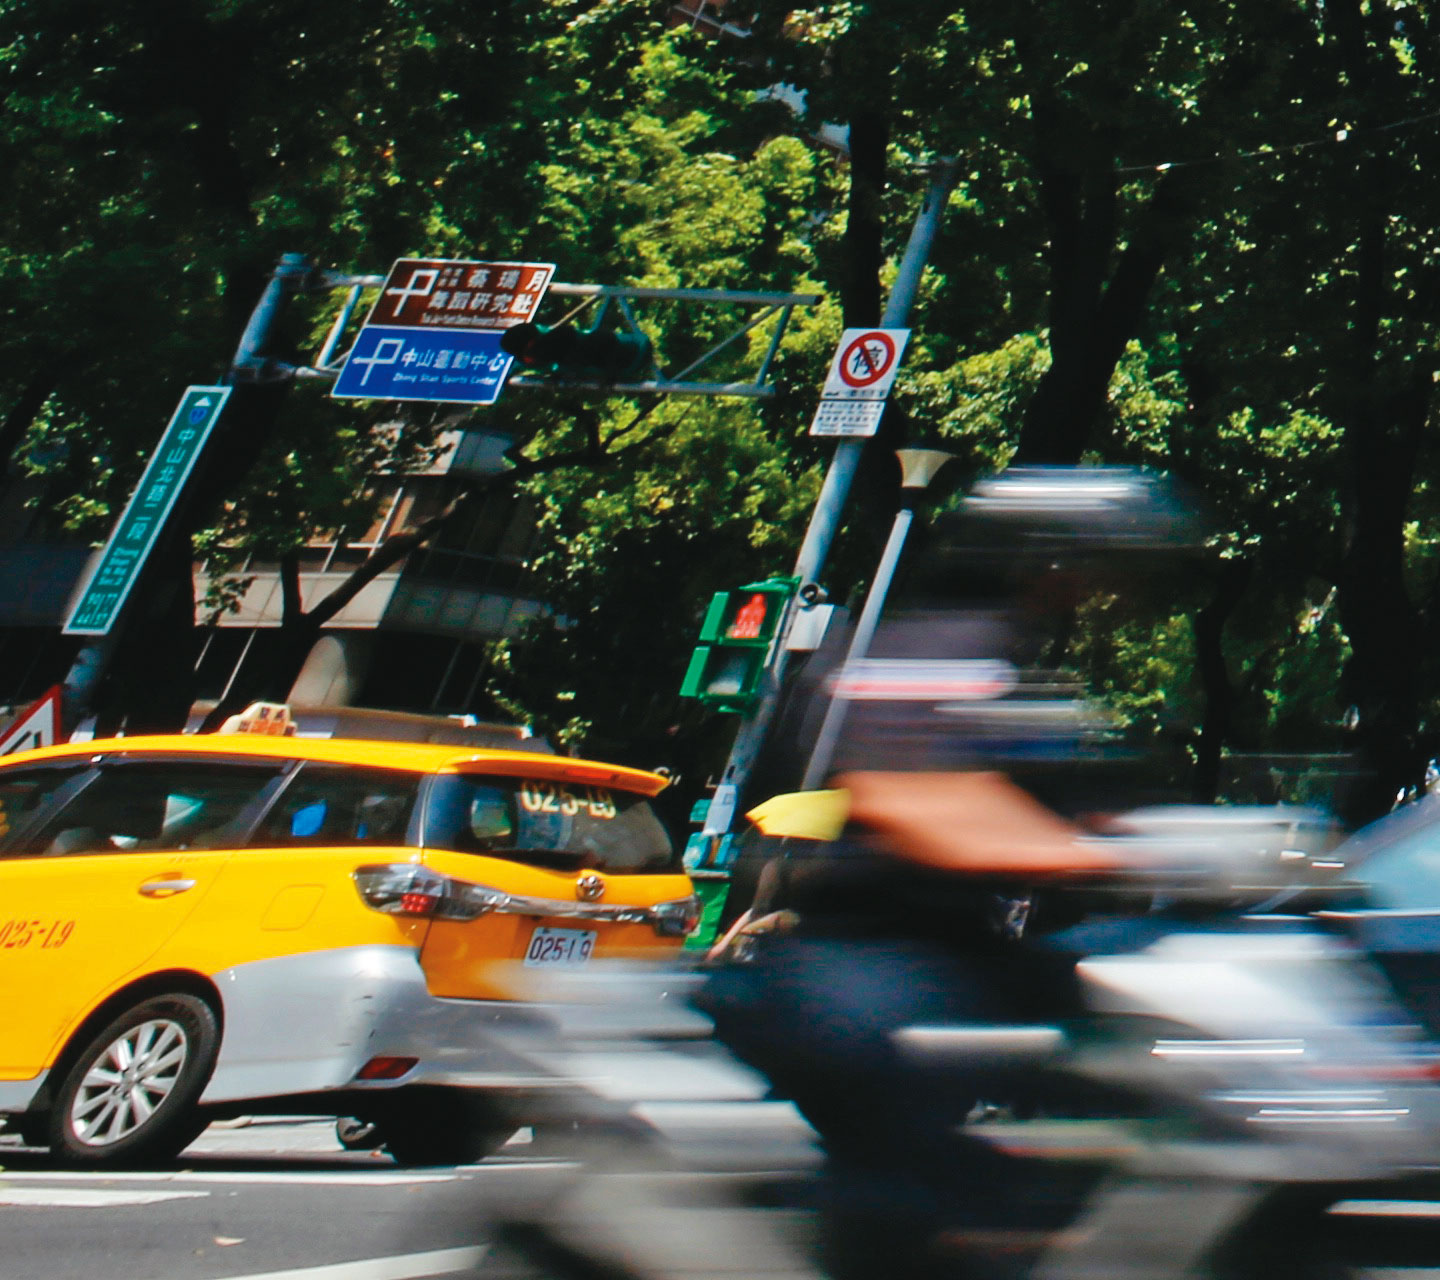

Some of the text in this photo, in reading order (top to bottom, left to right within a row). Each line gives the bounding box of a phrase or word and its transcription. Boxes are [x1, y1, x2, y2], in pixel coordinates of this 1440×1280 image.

[401, 348, 505, 372] 中山運動中心
